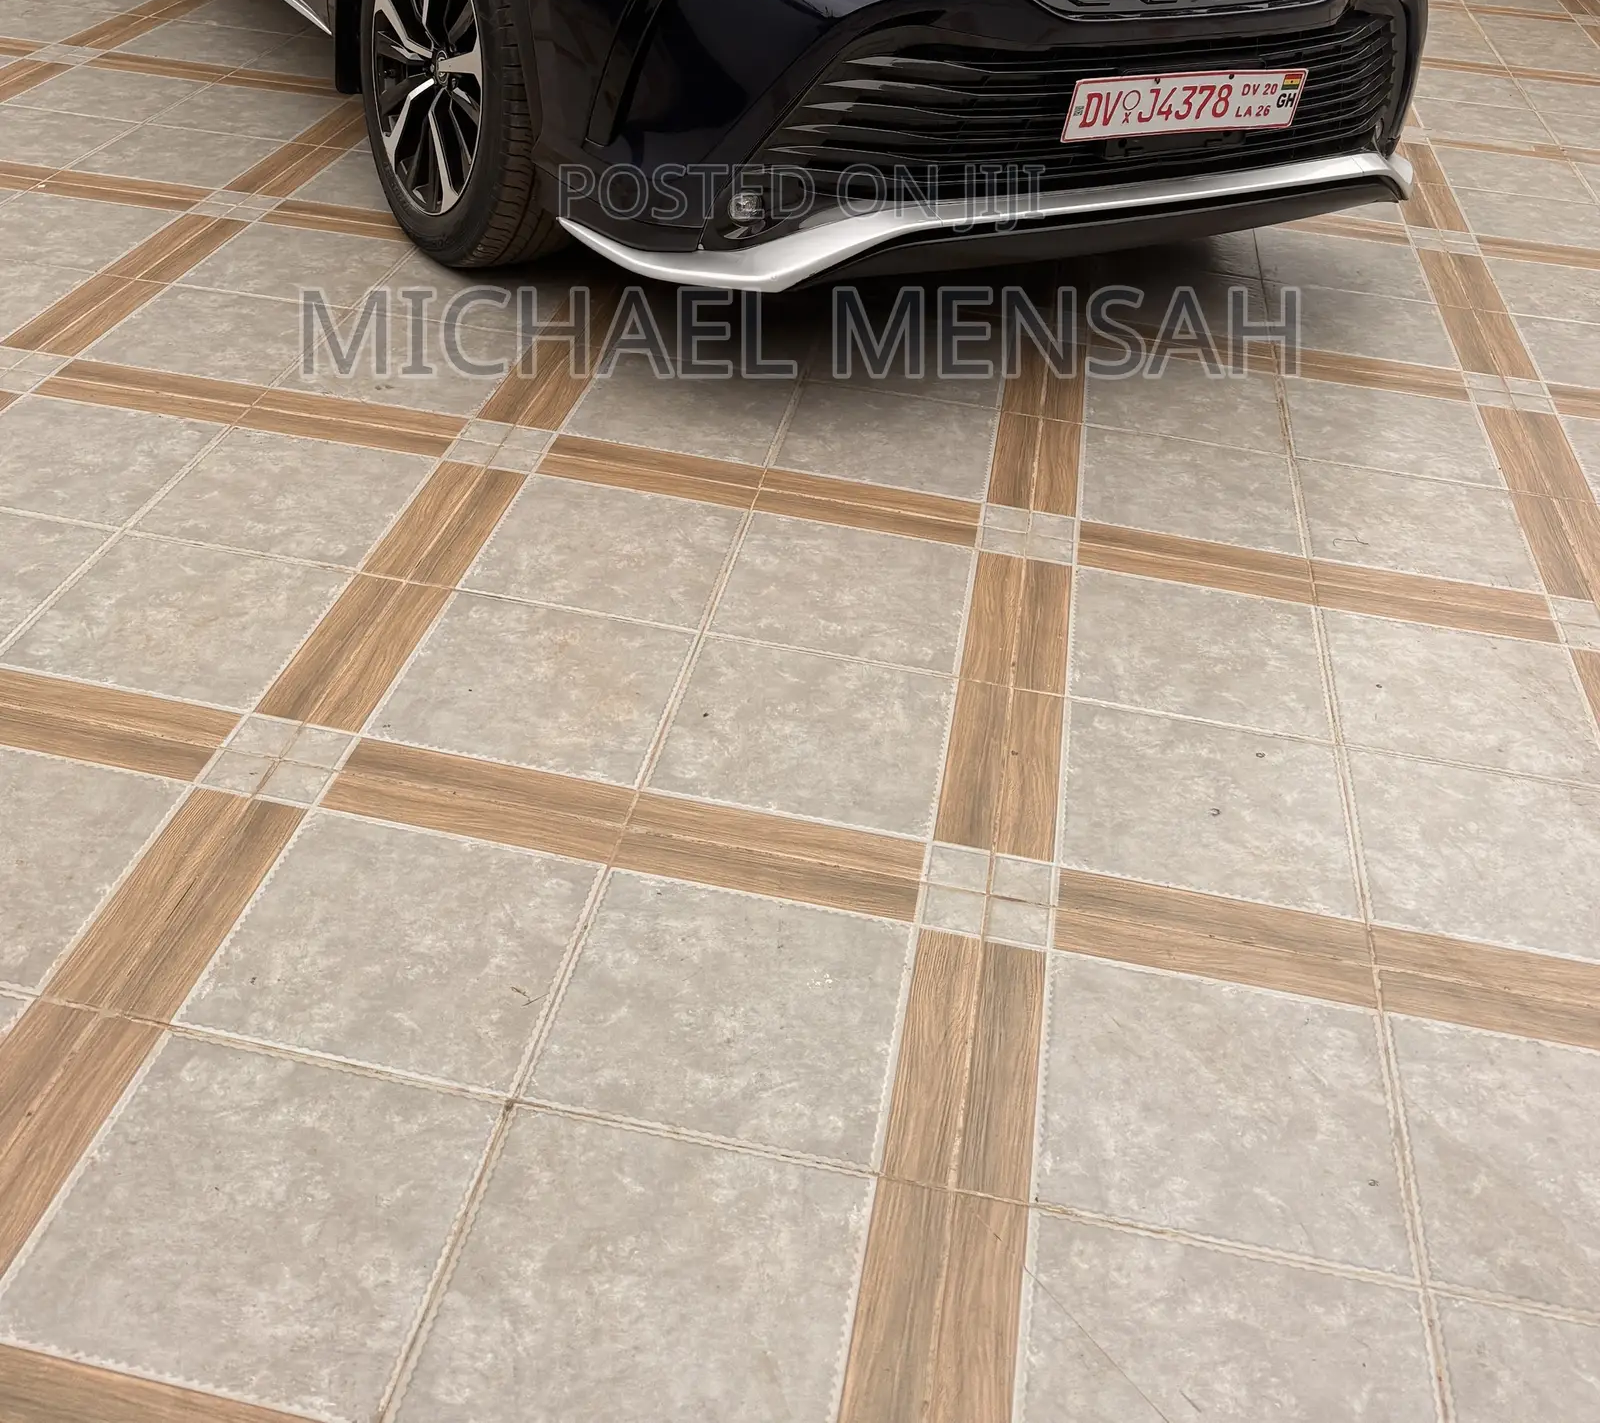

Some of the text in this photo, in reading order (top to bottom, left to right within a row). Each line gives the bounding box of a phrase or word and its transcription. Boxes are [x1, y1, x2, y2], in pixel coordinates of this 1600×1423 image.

[1241, 83, 1278, 96] DV 20
[1079, 91, 1122, 128] DV
[1138, 84, 1233, 123] J4378
[1276, 93, 1297, 108] GH
[1235, 105, 1271, 118] LA 26
